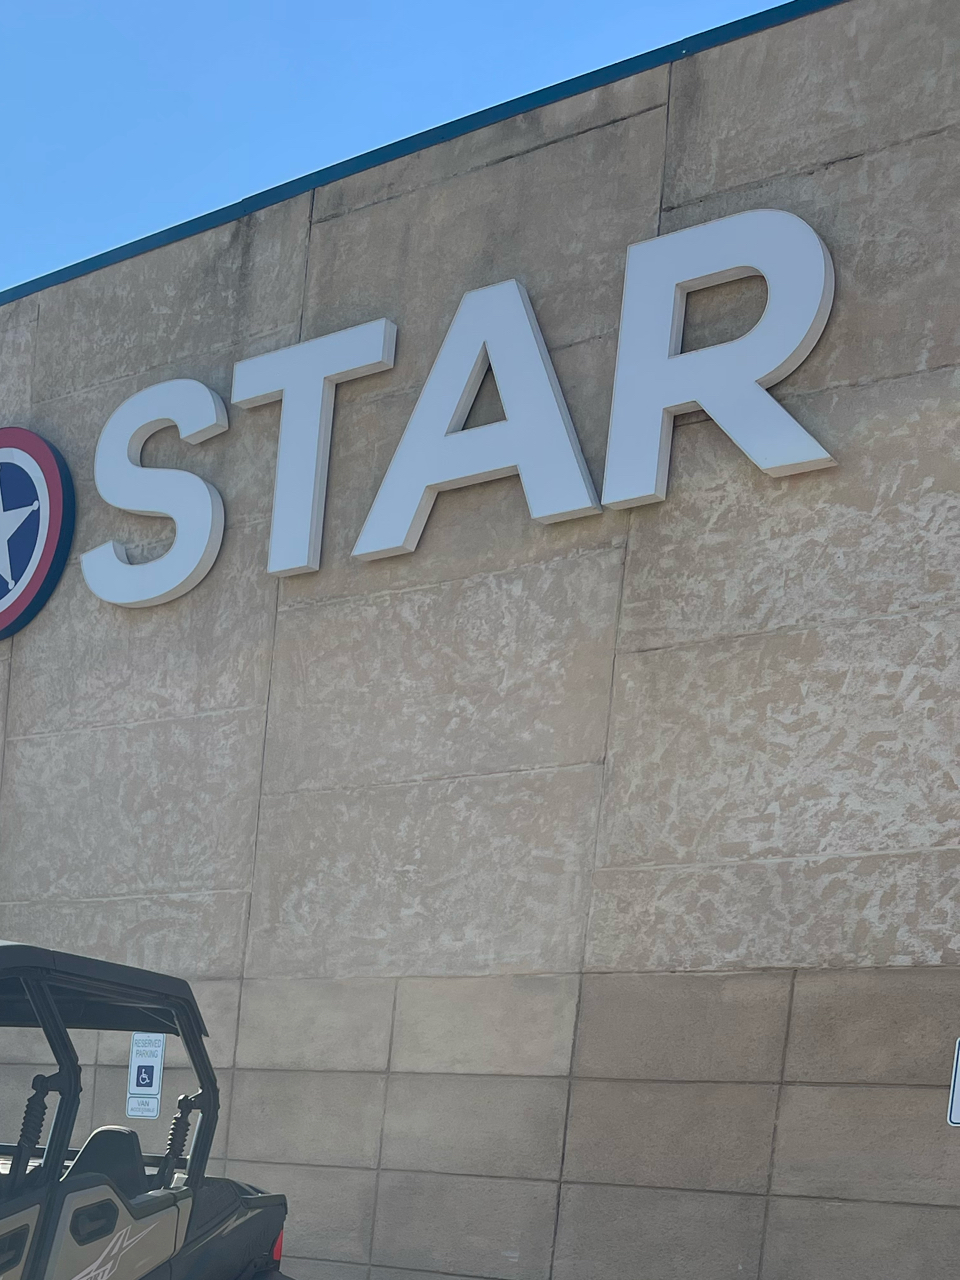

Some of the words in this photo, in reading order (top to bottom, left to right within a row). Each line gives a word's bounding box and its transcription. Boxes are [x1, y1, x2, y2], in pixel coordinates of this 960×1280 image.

[80, 208, 837, 609] STAR
[134, 1039, 162, 1048] RESERVED
[135, 1049, 159, 1059] PARKING
[137, 1099, 150, 1107] VAN
